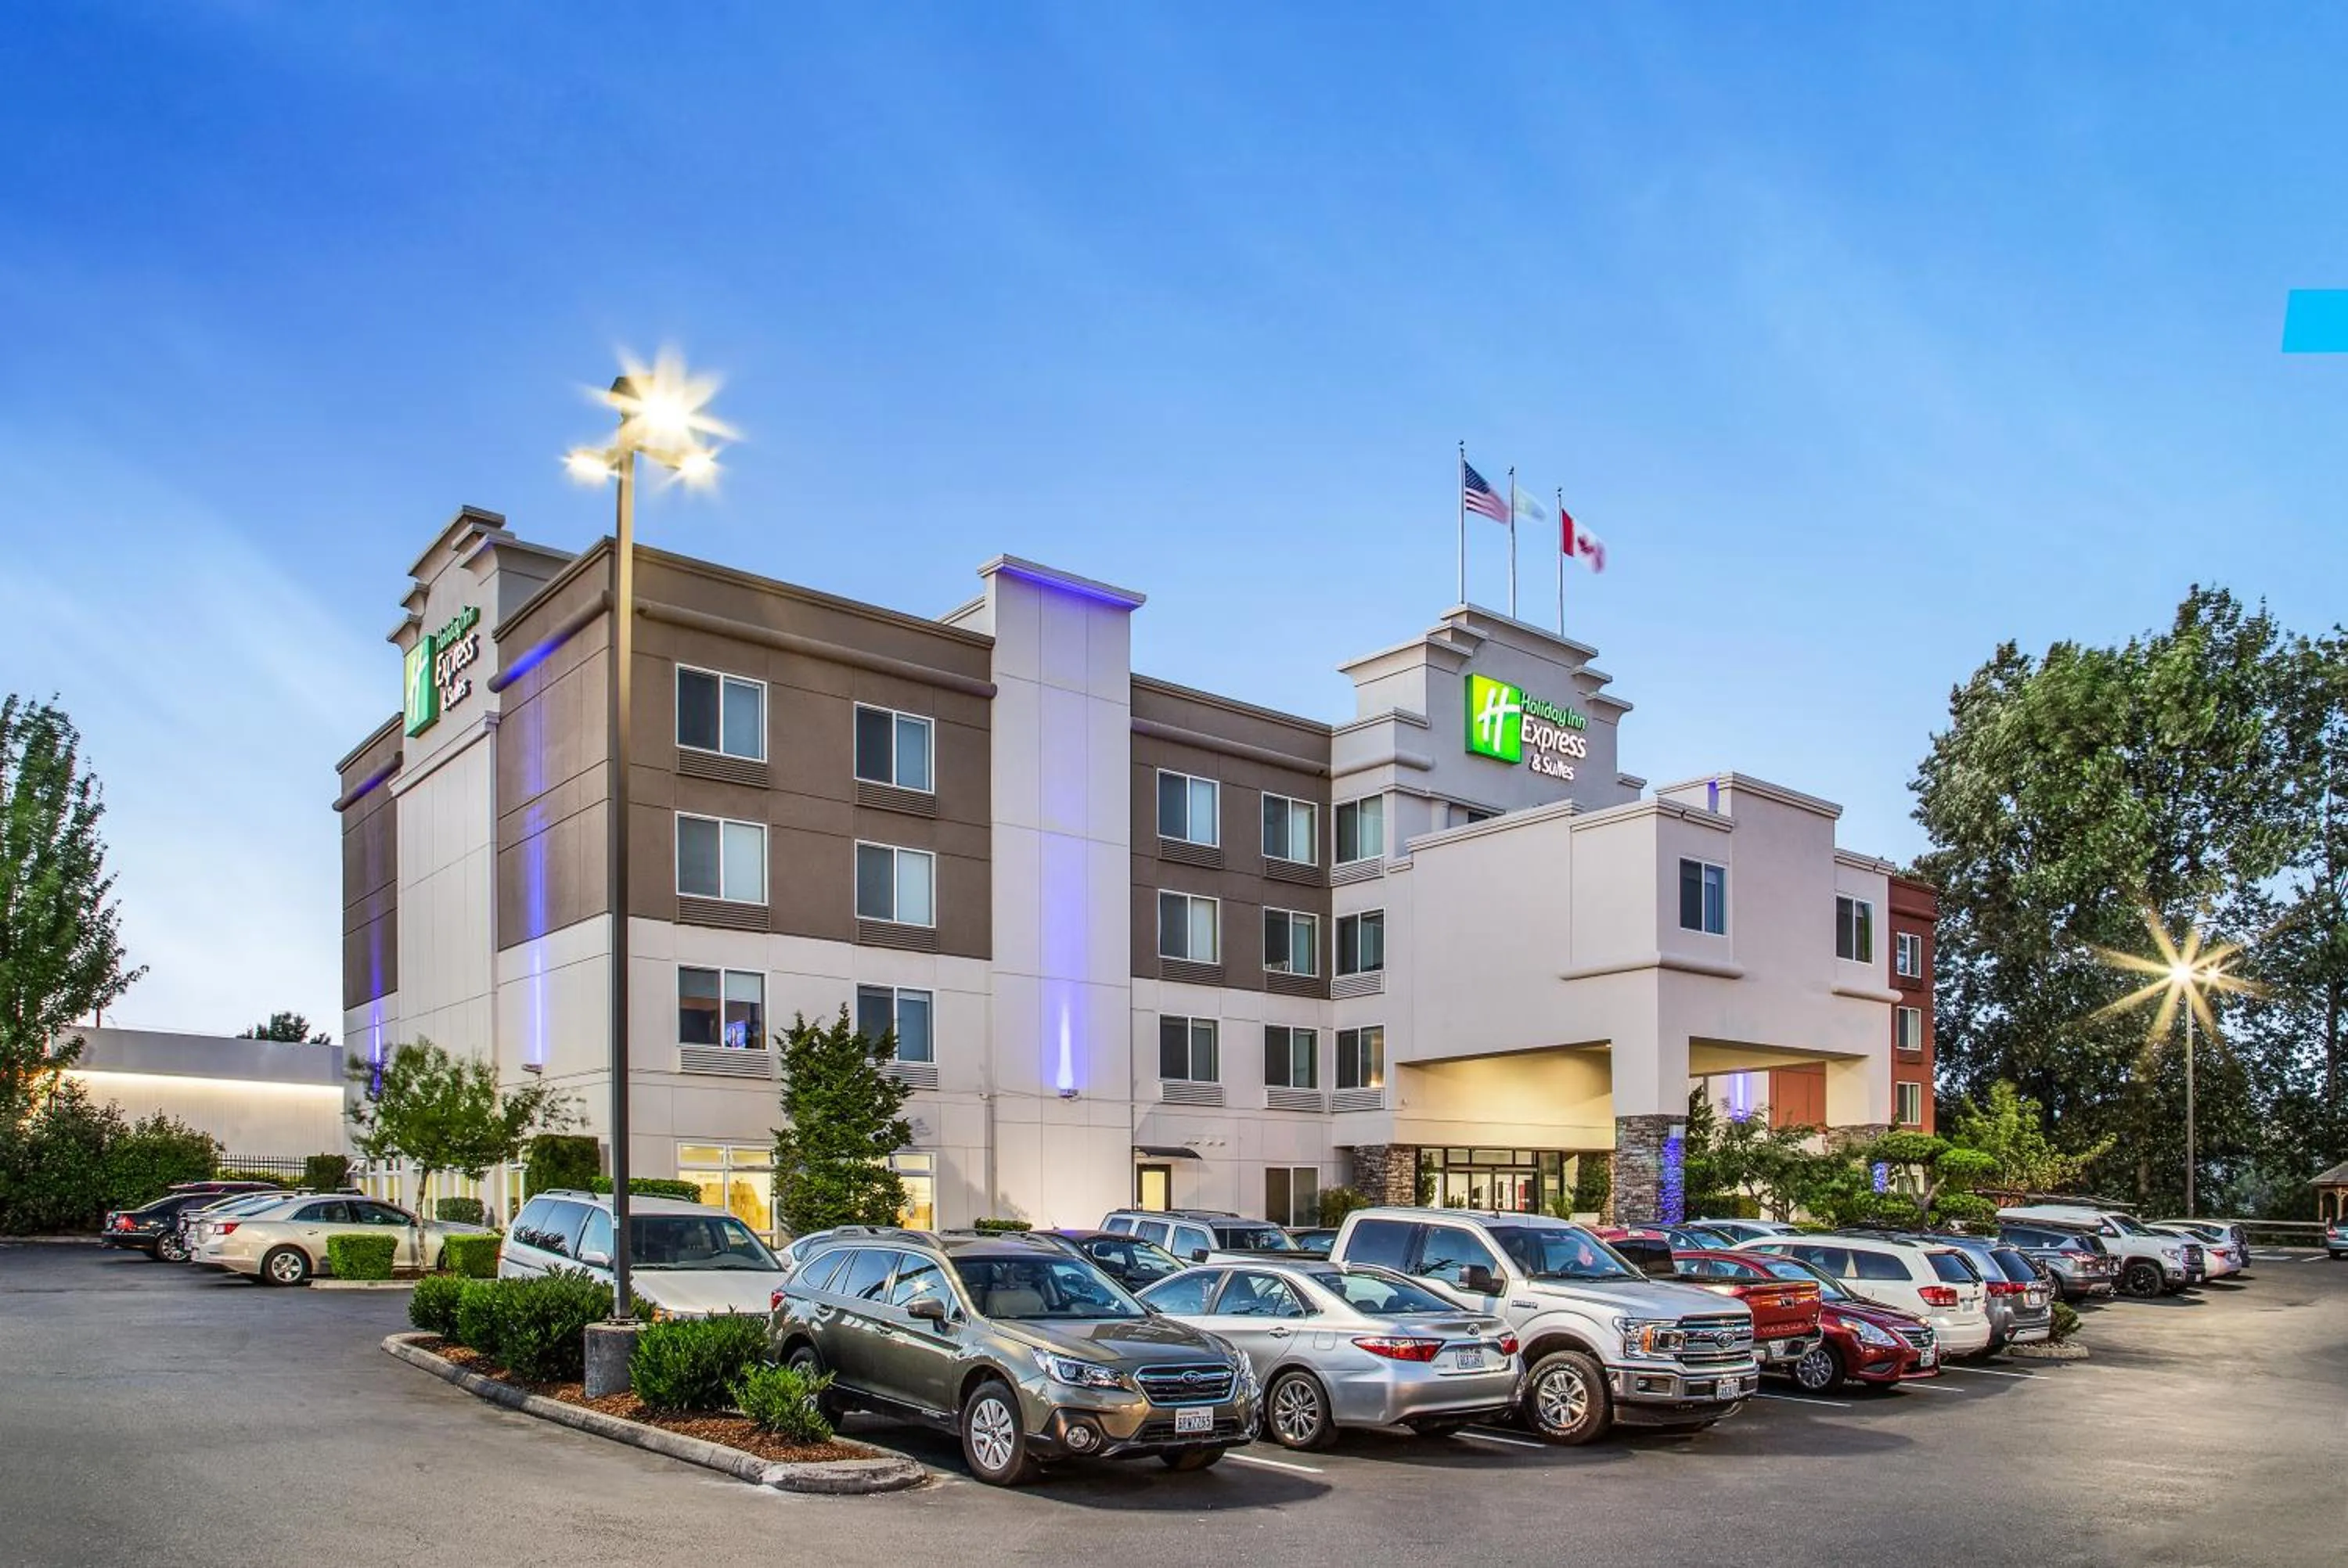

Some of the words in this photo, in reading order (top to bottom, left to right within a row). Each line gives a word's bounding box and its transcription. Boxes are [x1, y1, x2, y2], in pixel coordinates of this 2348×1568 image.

[1521, 692, 1566, 727] Holiday
[1567, 707, 1586, 732] Inn
[1522, 714, 1586, 758] Express
[1532, 753, 1541, 771] &
[1541, 756, 1575, 780] Suites
